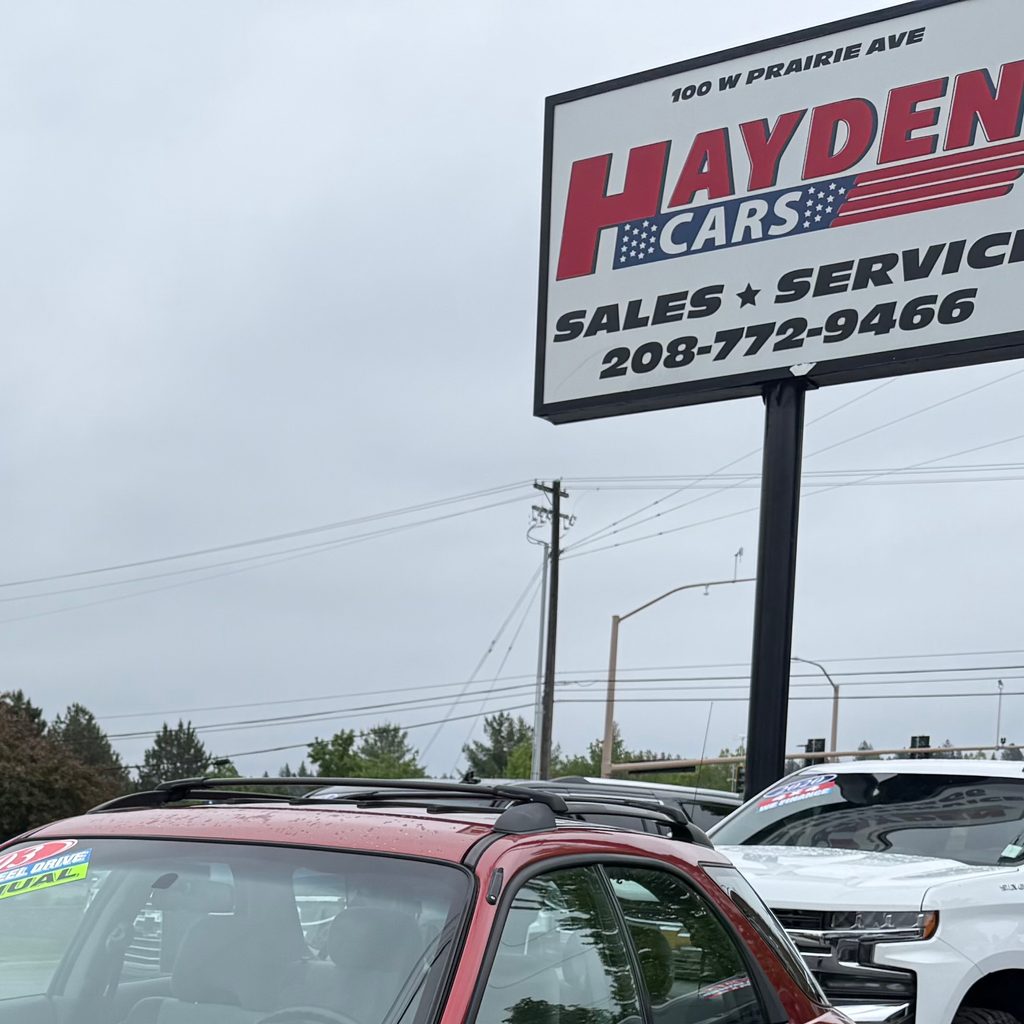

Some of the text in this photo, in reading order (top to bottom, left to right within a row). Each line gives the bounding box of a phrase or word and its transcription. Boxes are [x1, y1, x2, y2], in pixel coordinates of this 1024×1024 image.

[671, 27, 926, 103] 100 W PRAIRIE AVE
[556, 59, 1024, 282] HAYDEN
[658, 190, 803, 256] CARS
[553, 284, 725, 343] SALES
[599, 288, 978, 380] 208-772-9466
[30, 850, 89, 874] DRIVE
